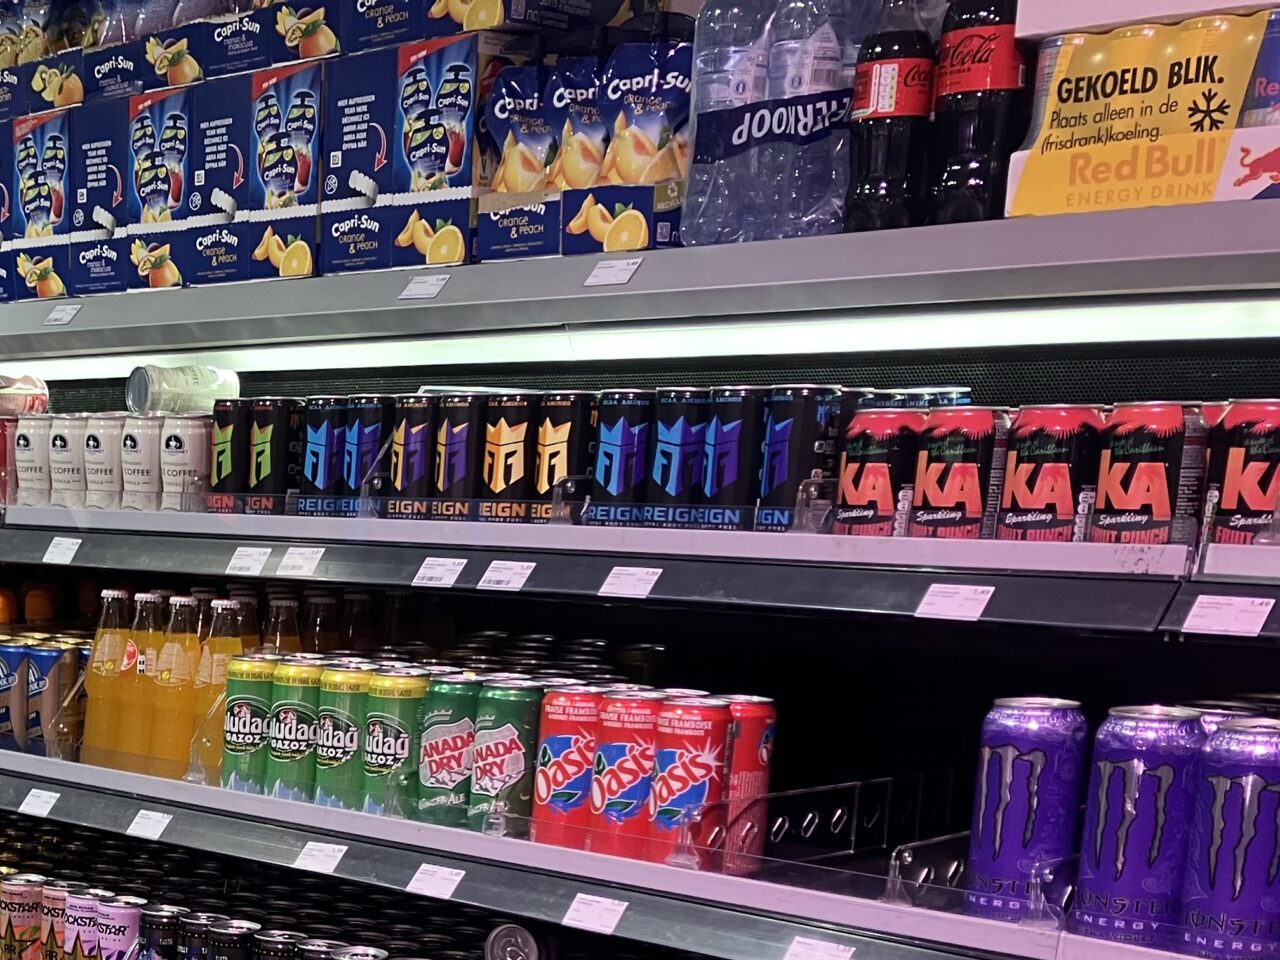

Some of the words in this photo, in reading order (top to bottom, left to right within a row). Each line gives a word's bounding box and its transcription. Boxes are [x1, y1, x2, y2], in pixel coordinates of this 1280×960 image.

[214, 17, 260, 42] Capri-Sun
[94, 55, 134, 78] Capri-Sun
[1056, 66, 1158, 104] GEKOELD
[1167, 55, 1225, 90] BLIK.
[1254, 77, 1280, 98] Re
[403, 91, 429, 108] Capri-Sun
[437, 96, 469, 109] Capri-Sun
[1049, 110, 1089, 130] Plaats
[1093, 102, 1134, 124] alleen
[1140, 99, 1153, 117] in
[1158, 94, 1179, 114] de
[410, 142, 447, 162] Capri-Sun
[1069, 144, 1139, 187] Red
[1144, 136, 1218, 182] Bull
[264, 163, 295, 181] Capri-Sun
[140, 181, 168, 197] Capri-Sun
[1066, 186, 1144, 208] ENERGY
[1150, 180, 1214, 200] DRINK
[332, 215, 379, 237] Capri-Sun
[196, 230, 238, 250] Capri-Sun
[339, 233, 365, 246] orange
[79, 248, 117, 265] Capri-Sun
[18, 466, 43, 474] COFFEE
[53, 467, 81, 475] COFFEE
[87, 468, 113, 476] COFFEE
[124, 469, 151, 477] COFFEE
[167, 469, 198, 478] COFFEE
[837, 451, 894, 515] KA
[913, 450, 983, 518] KA
[1002, 450, 1073, 519] KA
[1096, 449, 1171, 521] KA
[387, 500, 427, 514] EIGN
[432, 501, 469, 515] EIGN
[916, 510, 962, 522] Sparkling
[1005, 511, 1053, 524] Sparkling
[1099, 512, 1149, 525] Sparkling
[225, 733, 261, 744] GAZOZ
[271, 739, 307, 750] GAZOZ
[422, 731, 475, 760] ANADA
[428, 752, 464, 777] DRY
[475, 758, 506, 782] DRY
